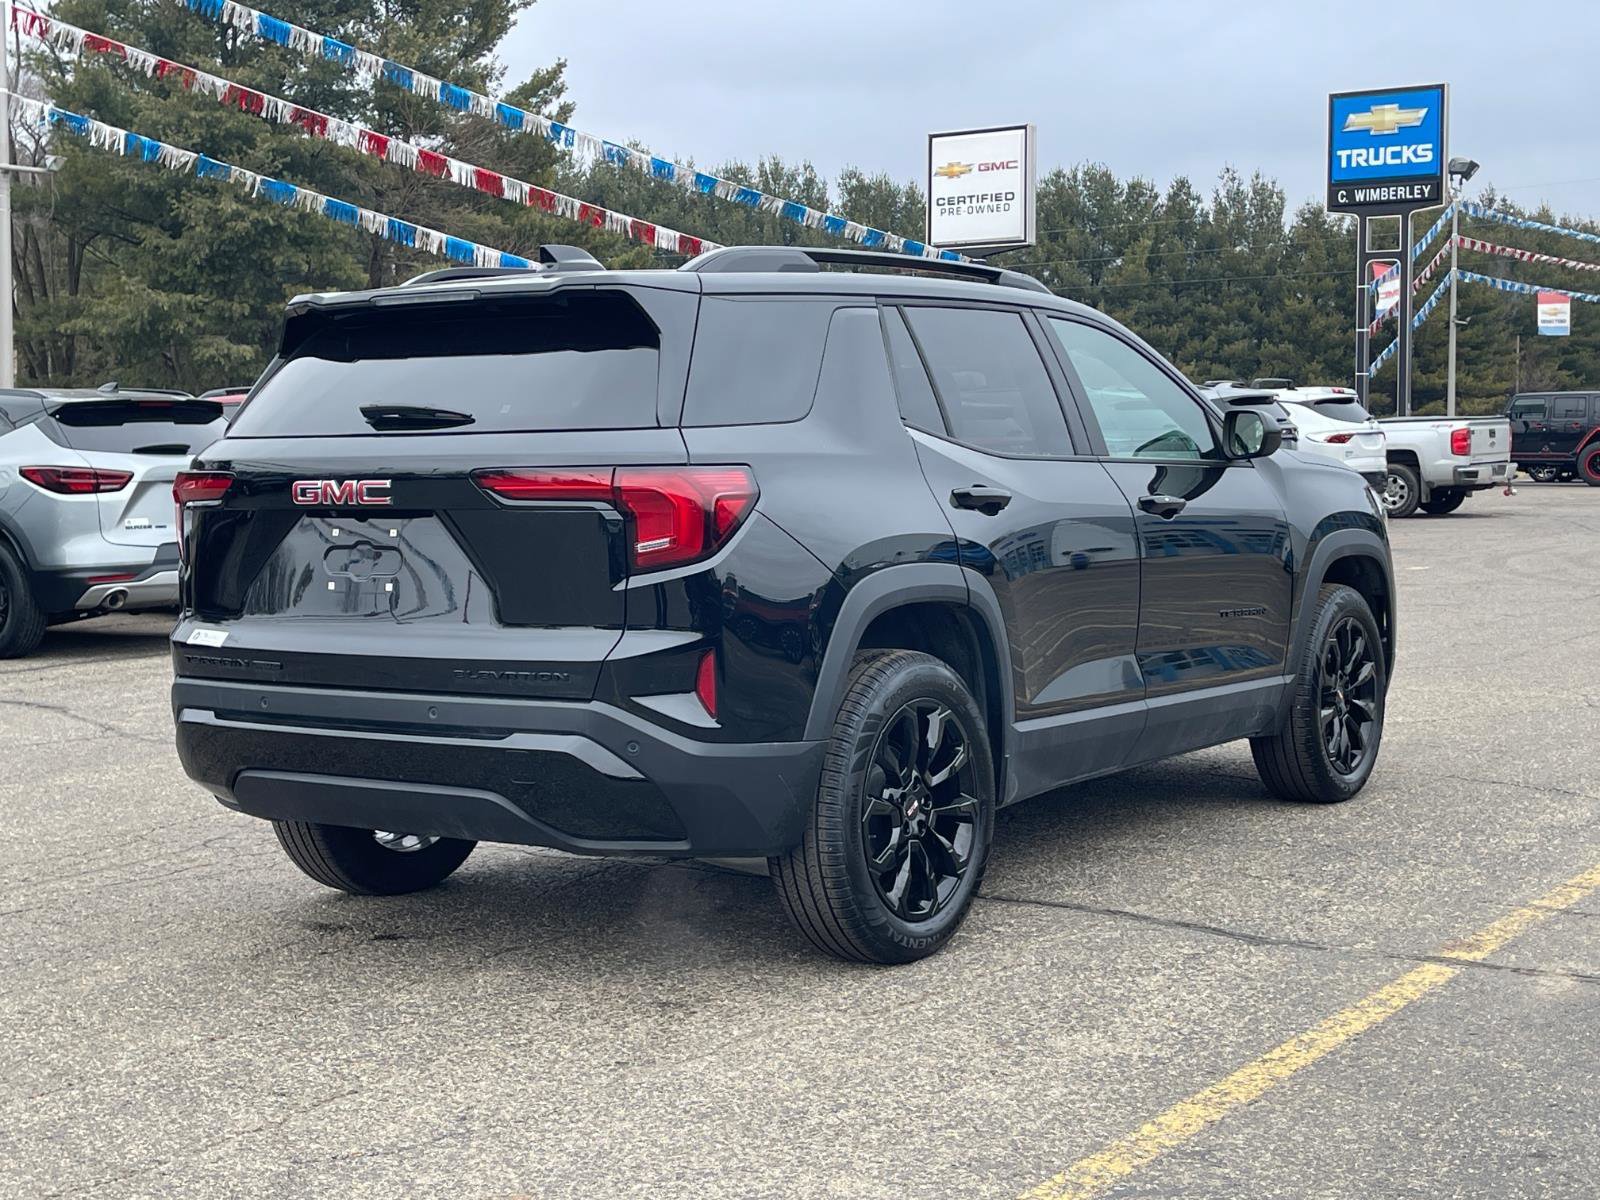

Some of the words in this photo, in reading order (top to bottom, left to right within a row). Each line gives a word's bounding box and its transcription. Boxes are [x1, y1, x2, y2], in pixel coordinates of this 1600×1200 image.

[1336, 143, 1433, 168] TRUCKS
[978, 160, 1018, 172] GMC
[936, 192, 1015, 206] CERTIFIED
[1338, 190, 1349, 203] C.
[1354, 185, 1431, 202] WIMBERLEY
[940, 202, 1011, 216] PRE-OWNED
[292, 480, 392, 505] GMC
[453, 669, 569, 682] ELEVATION
